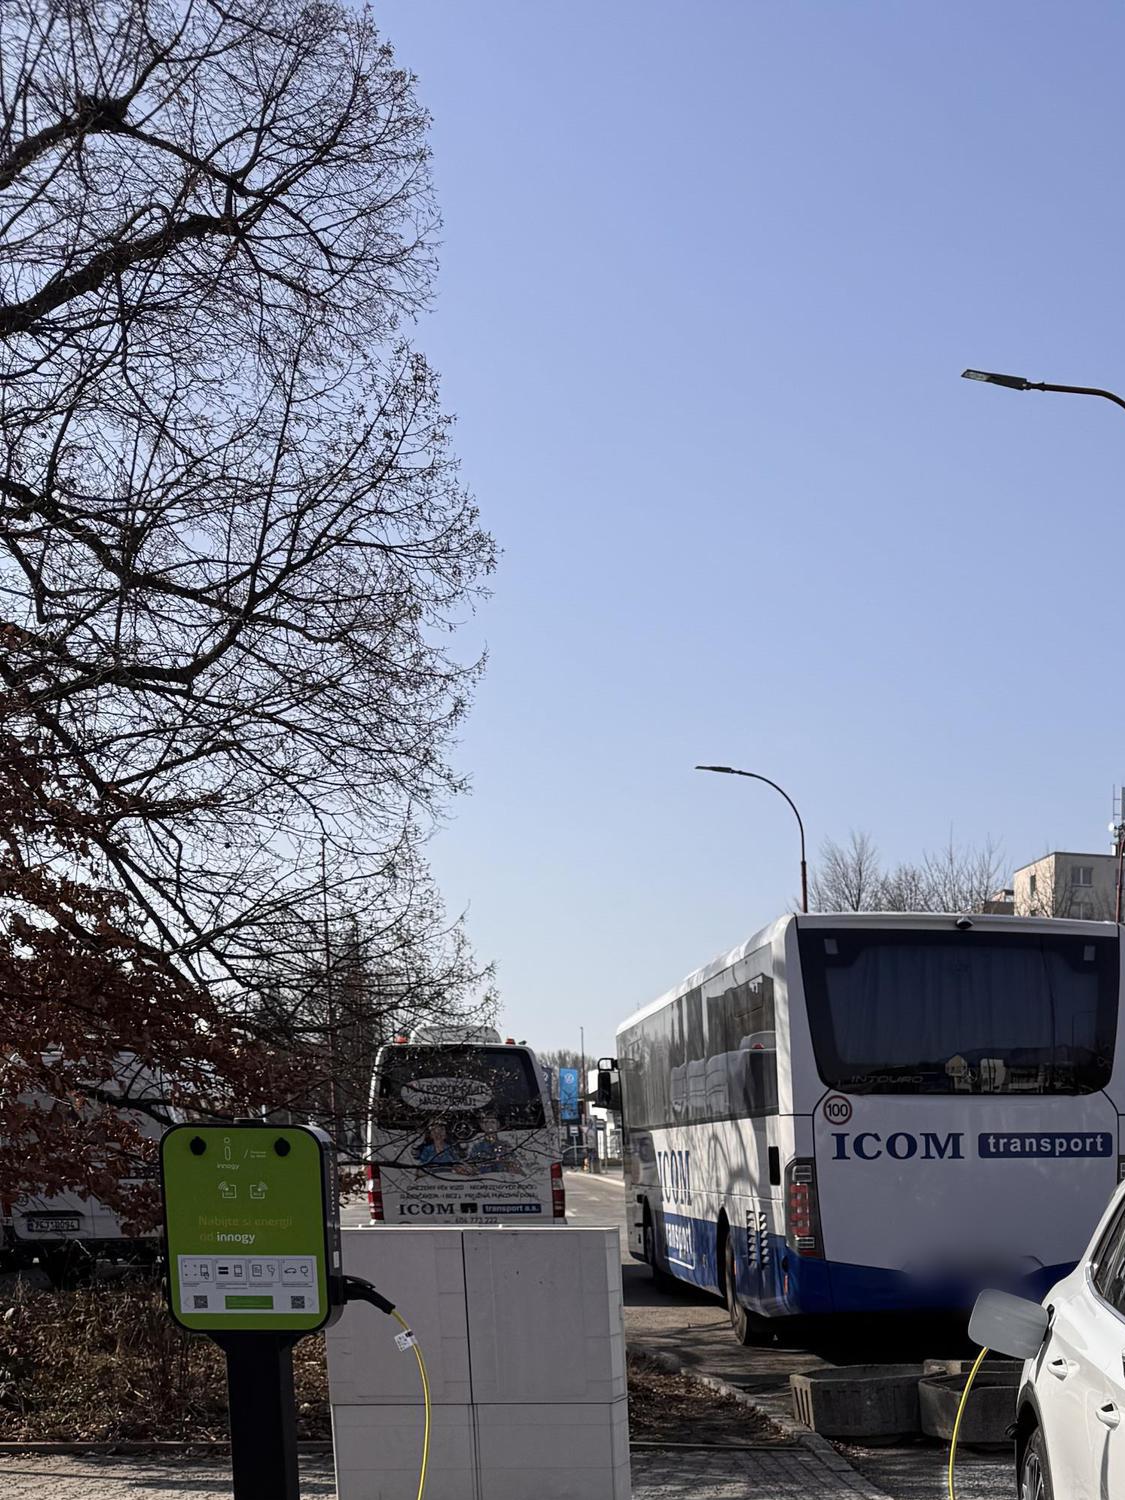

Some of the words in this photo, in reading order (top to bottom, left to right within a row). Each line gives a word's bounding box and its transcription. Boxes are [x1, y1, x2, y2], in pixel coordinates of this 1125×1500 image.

[851, 1075, 924, 1084] INTOURO
[827, 1103, 848, 1117] 100
[830, 1132, 966, 1161] ICOM
[987, 1135, 1104, 1156] transport
[657, 1149, 692, 1206] ICOM
[398, 1203, 456, 1216] ICOM
[216, 1231, 256, 1244] innogy
